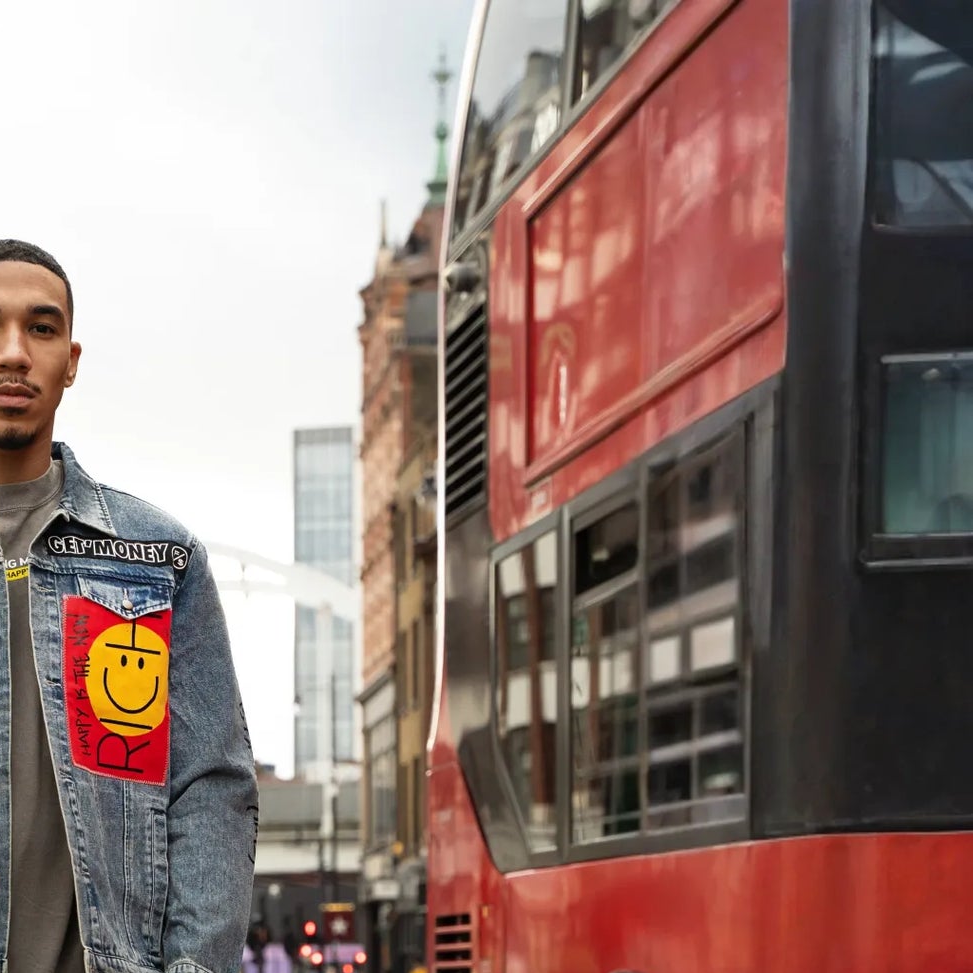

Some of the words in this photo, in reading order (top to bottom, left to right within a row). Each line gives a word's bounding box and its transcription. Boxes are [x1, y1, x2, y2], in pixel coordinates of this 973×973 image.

[67, 614, 90, 646] NOW
[73, 653, 90, 684] THE
[76, 688, 89, 700] IS
[76, 707, 91, 756] HAPPY
